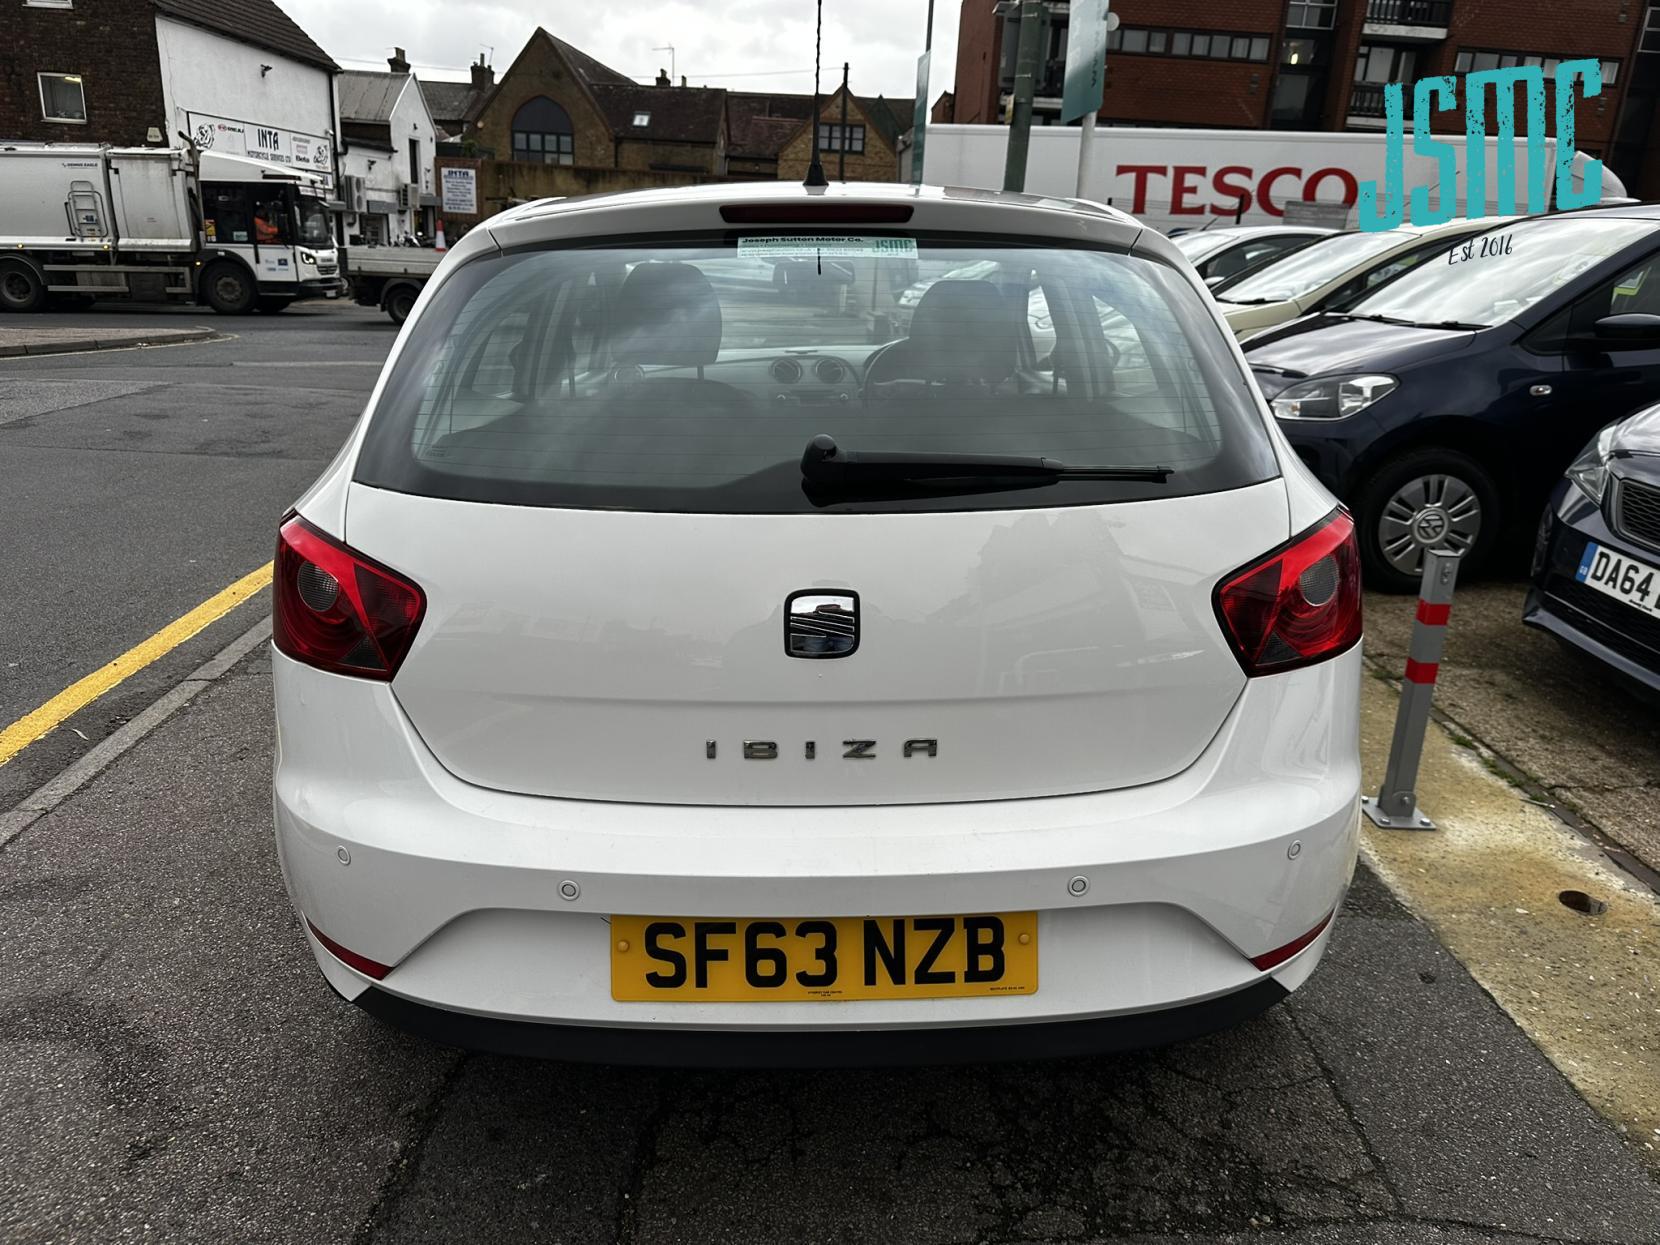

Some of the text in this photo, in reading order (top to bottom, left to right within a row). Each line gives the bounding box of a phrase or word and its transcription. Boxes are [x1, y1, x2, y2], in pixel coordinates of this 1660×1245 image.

[257, 128, 279, 151] INTA
[1116, 165, 1358, 217] TESCO
[1590, 551, 1655, 603] DA64
[706, 739, 937, 760] IBIZA
[644, 915, 1006, 988] SF63 NZB
